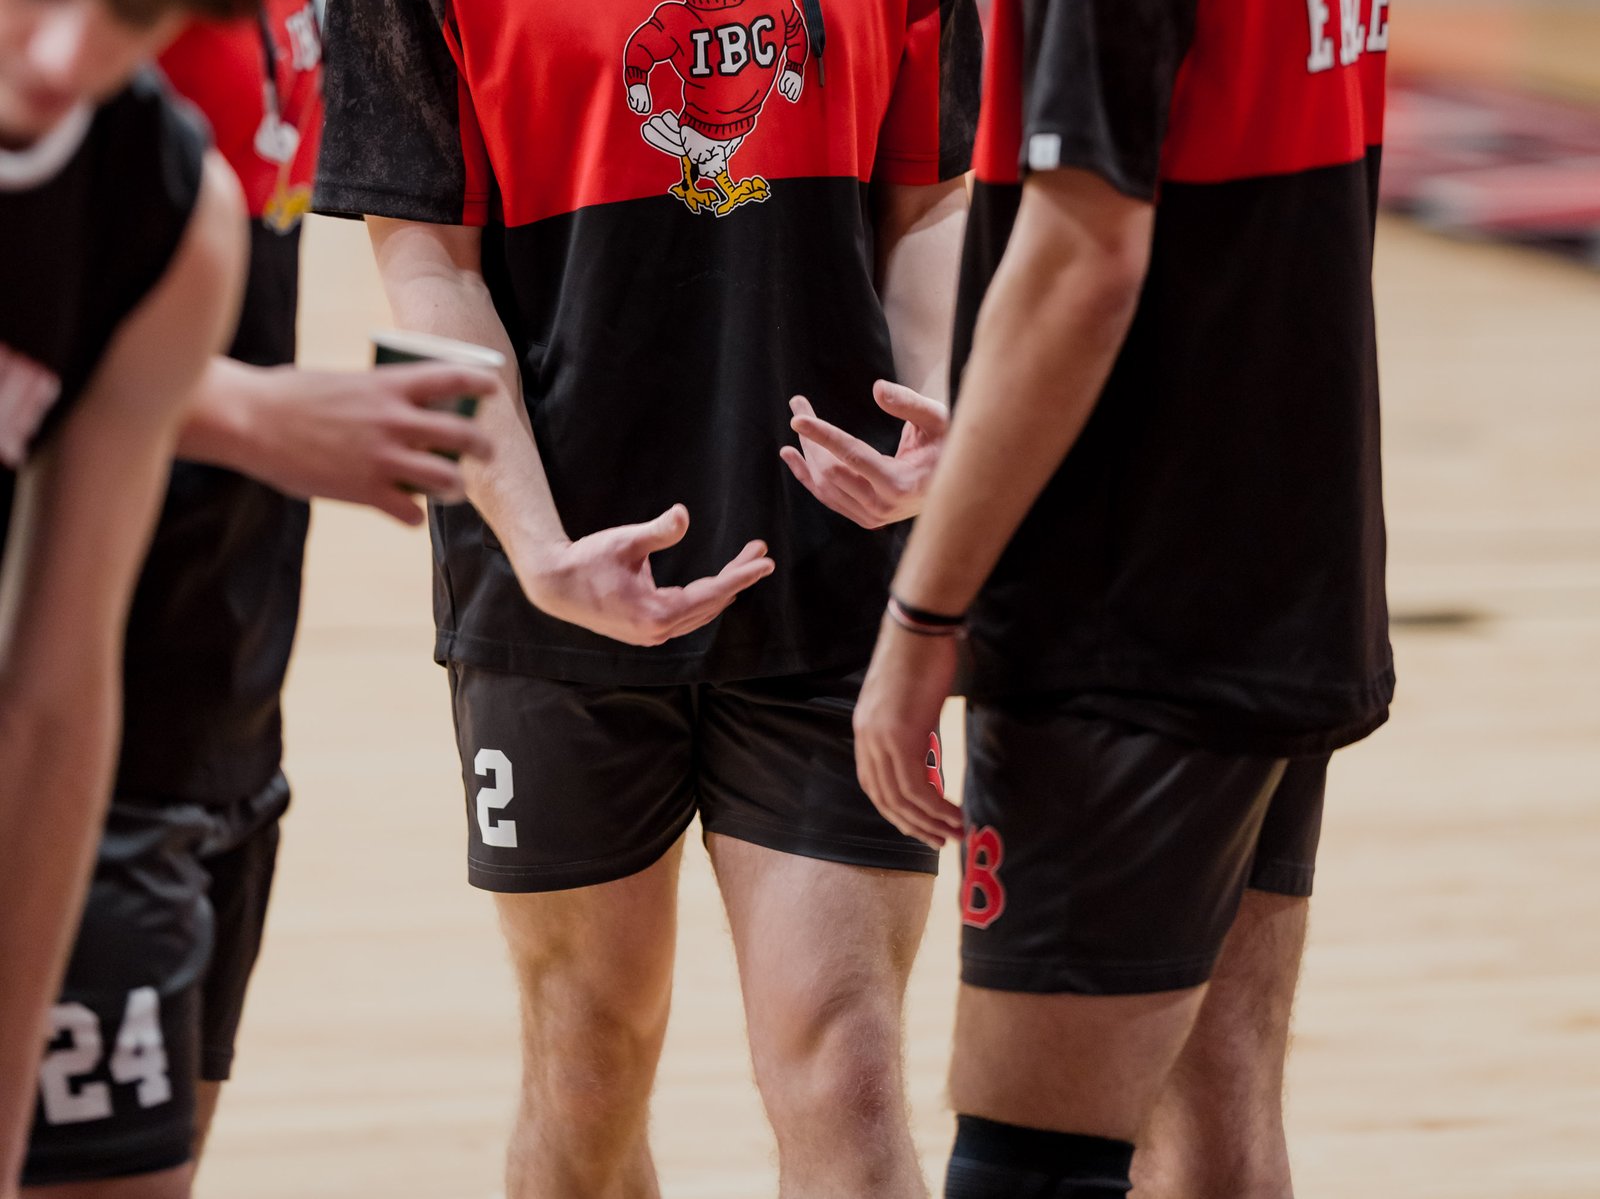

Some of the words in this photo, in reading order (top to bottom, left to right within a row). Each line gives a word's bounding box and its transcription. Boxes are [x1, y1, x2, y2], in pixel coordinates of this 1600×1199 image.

[689, 17, 778, 77] IBC
[474, 748, 518, 848] 2
[962, 825, 1005, 930] B
[38, 985, 172, 1126] 24
